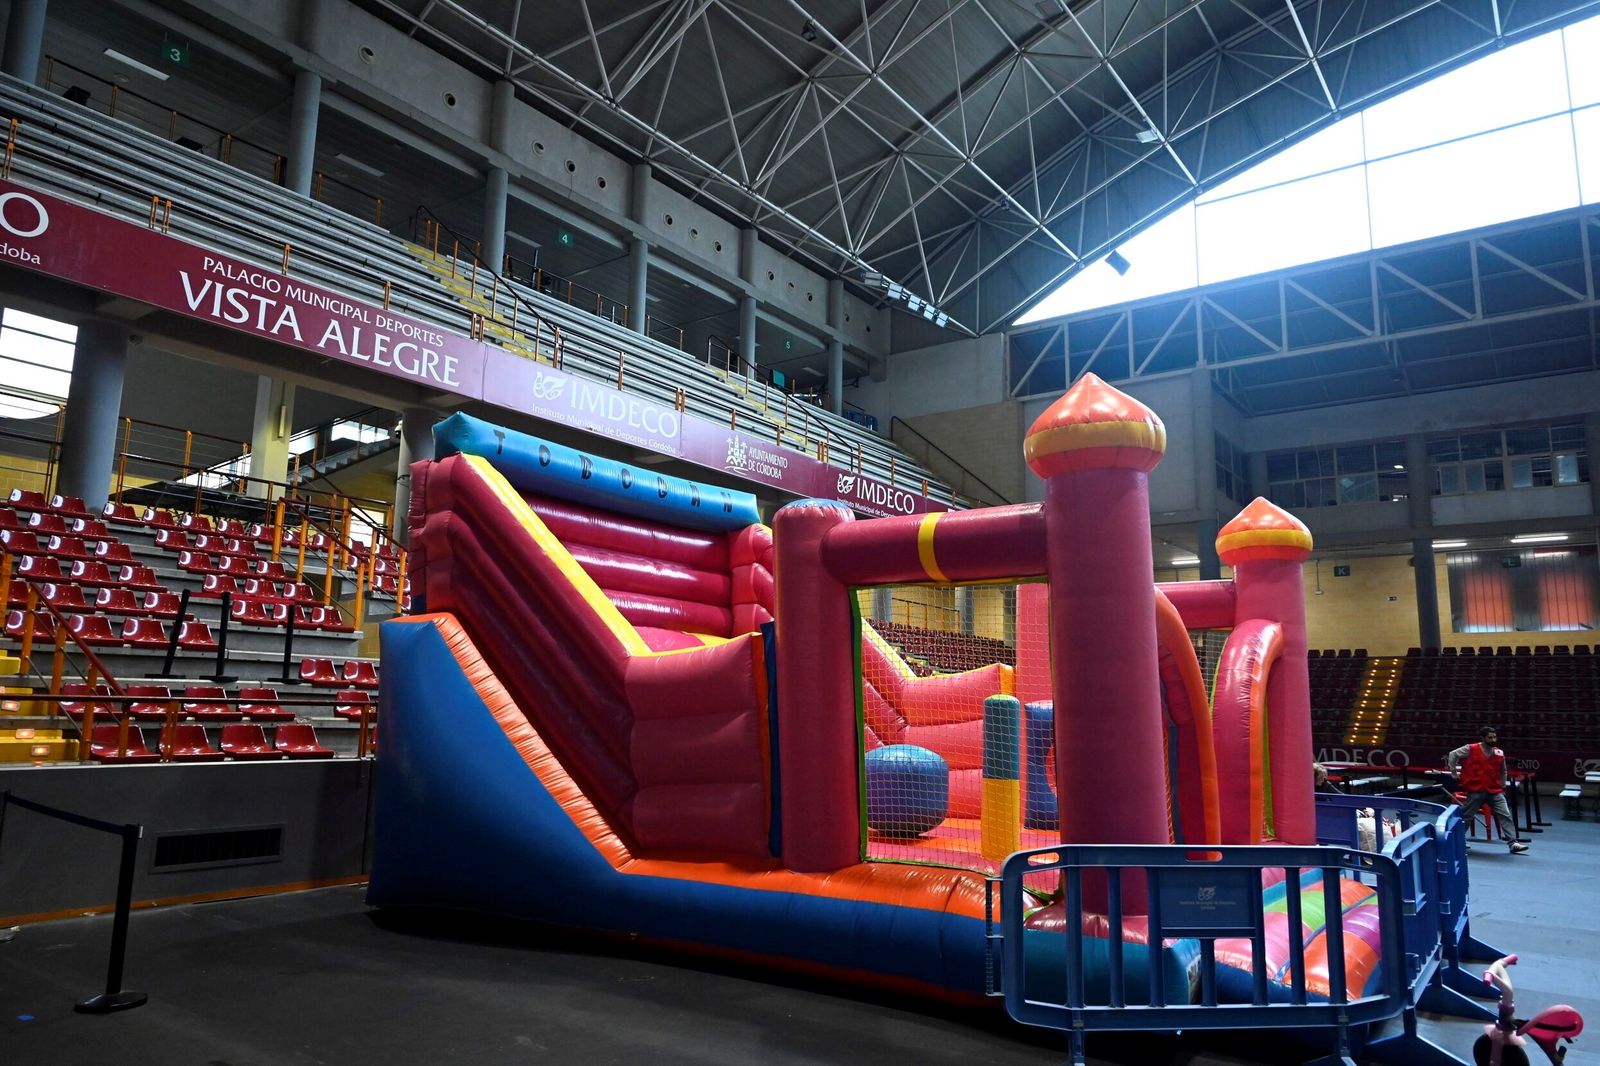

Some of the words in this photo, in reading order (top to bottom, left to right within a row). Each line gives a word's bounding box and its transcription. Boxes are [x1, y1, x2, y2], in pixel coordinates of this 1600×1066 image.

[170, 48, 181, 62] 3
[562, 234, 568, 244] 4
[203, 256, 281, 294] PALACIO
[285, 284, 371, 324] MUNICIPAL
[375, 314, 444, 347] DEPORTES
[179, 270, 304, 342] VISTA
[316, 318, 460, 388] ALEGRE
[785, 341, 791, 349] 5
[570, 379, 678, 439] IMDECO
[532, 403, 565, 420] Instituto
[604, 425, 615, 436] de
[616, 428, 648, 446] Deportes
[748, 446, 788, 469] AYUNTAMIENTO
[748, 459, 756, 472] DE
[756, 461, 782, 480] CÓRDOBA
[856, 477, 915, 514] IMDECO
[1338, 567, 1346, 576] K
